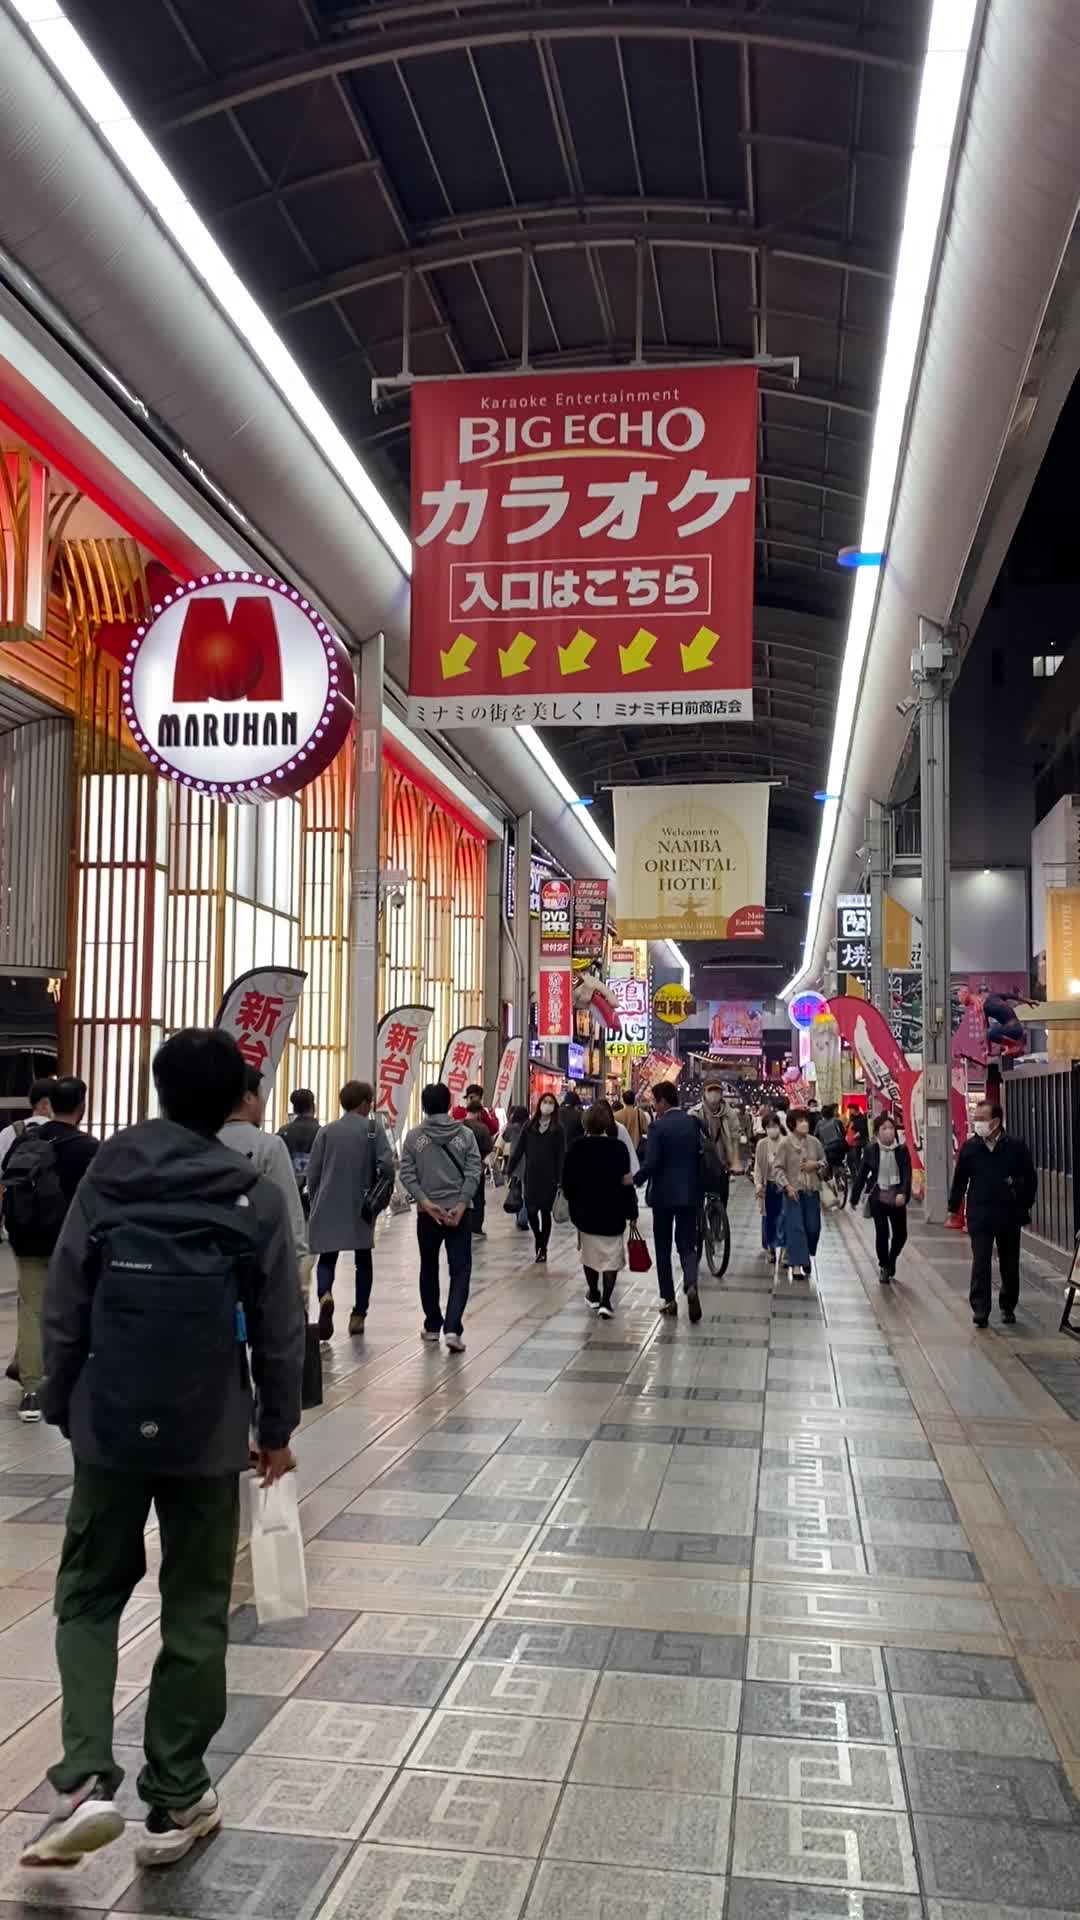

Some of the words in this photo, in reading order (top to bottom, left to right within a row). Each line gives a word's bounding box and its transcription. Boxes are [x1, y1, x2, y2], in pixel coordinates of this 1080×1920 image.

[480, 394, 548, 409] Karaoke
[556, 388, 680, 405] Entertainment
[459, 415, 552, 463] BIG
[563, 407, 706, 452] ECHO
[414, 469, 751, 548] カラオケ
[459, 564, 700, 613] 入口はこちら
[614, 699, 743, 717] ミナミ千日前商店会
[157, 711, 298, 748] MARUHAN
[662, 827, 707, 836] Welcome
[709, 827, 720, 836] to
[658, 839, 722, 854] NAMBA
[644, 858, 737, 873] ORIENTAL
[658, 877, 721, 891] HOTEL
[542, 911, 568, 922] DVD
[376, 1023, 419, 1128] 新台入
